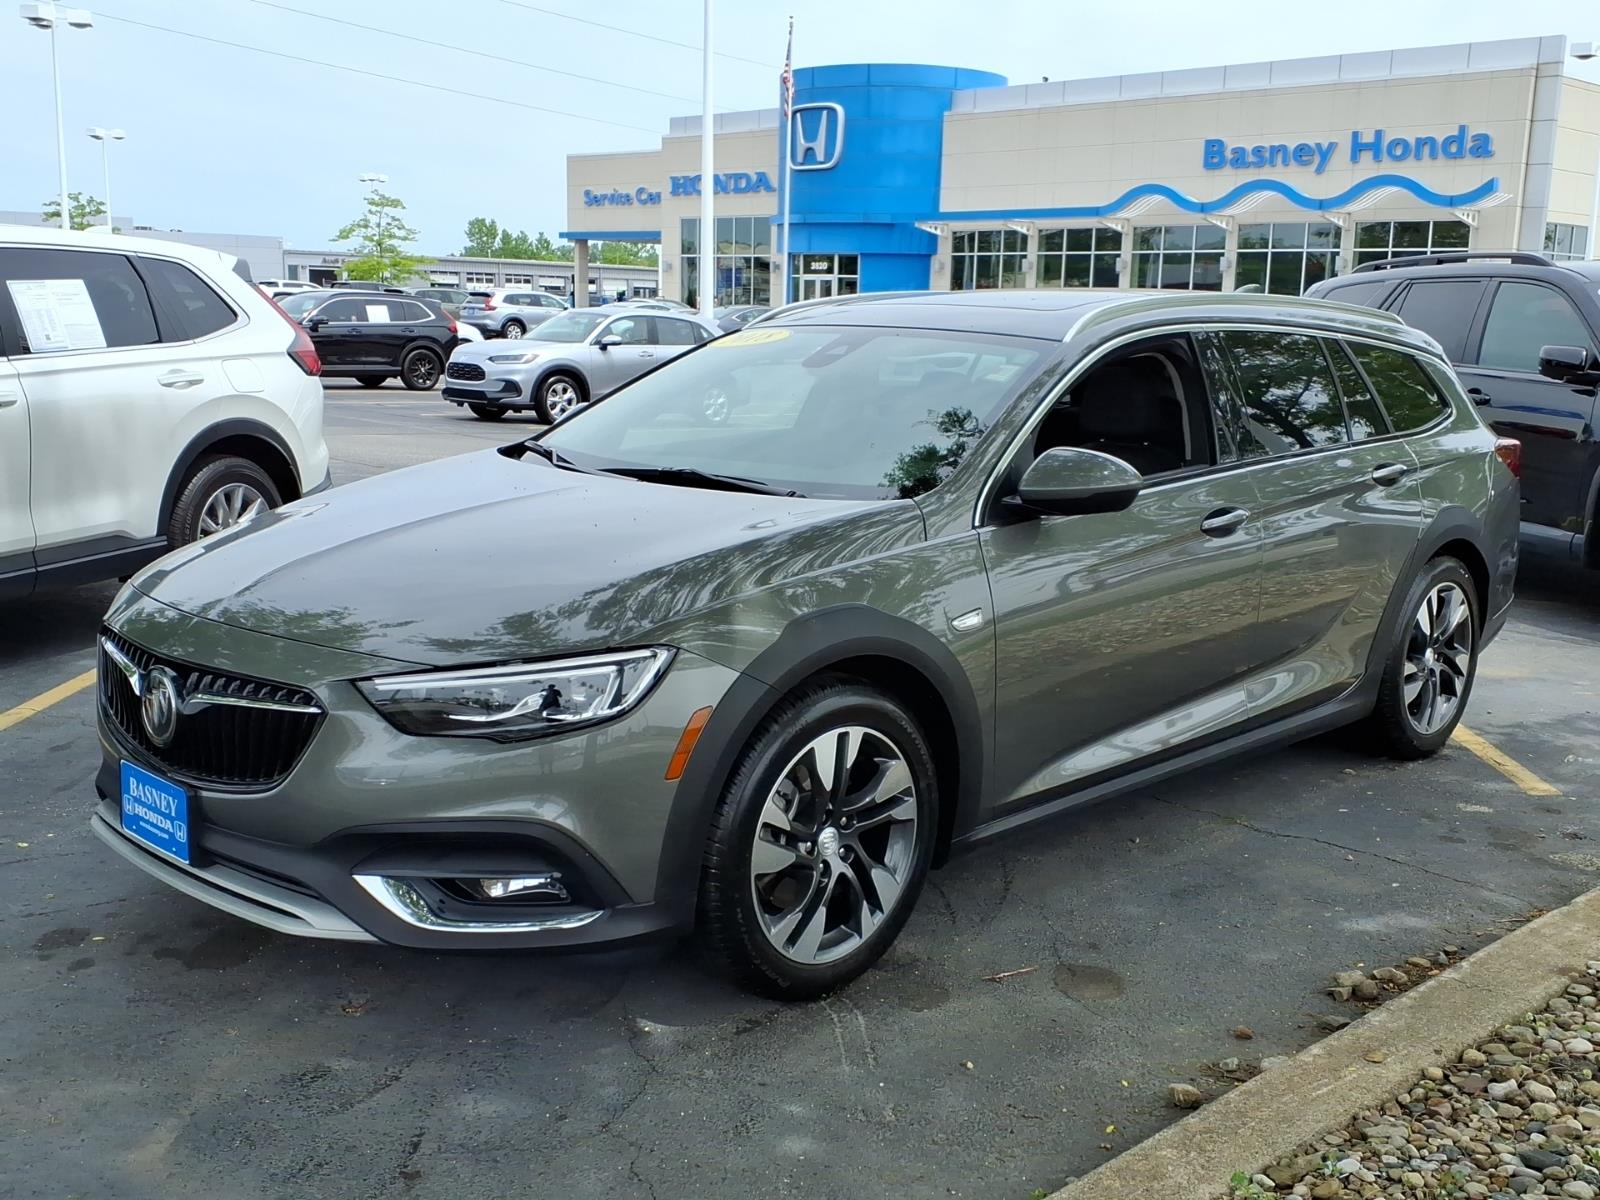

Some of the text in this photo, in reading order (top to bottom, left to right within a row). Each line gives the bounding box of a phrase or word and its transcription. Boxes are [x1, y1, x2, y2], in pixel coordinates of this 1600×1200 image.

[1202, 124, 1495, 175] Basney Honda
[583, 187, 633, 207] Service
[129, 776, 178, 817] BASNEY
[134, 802, 174, 833] HONDA
